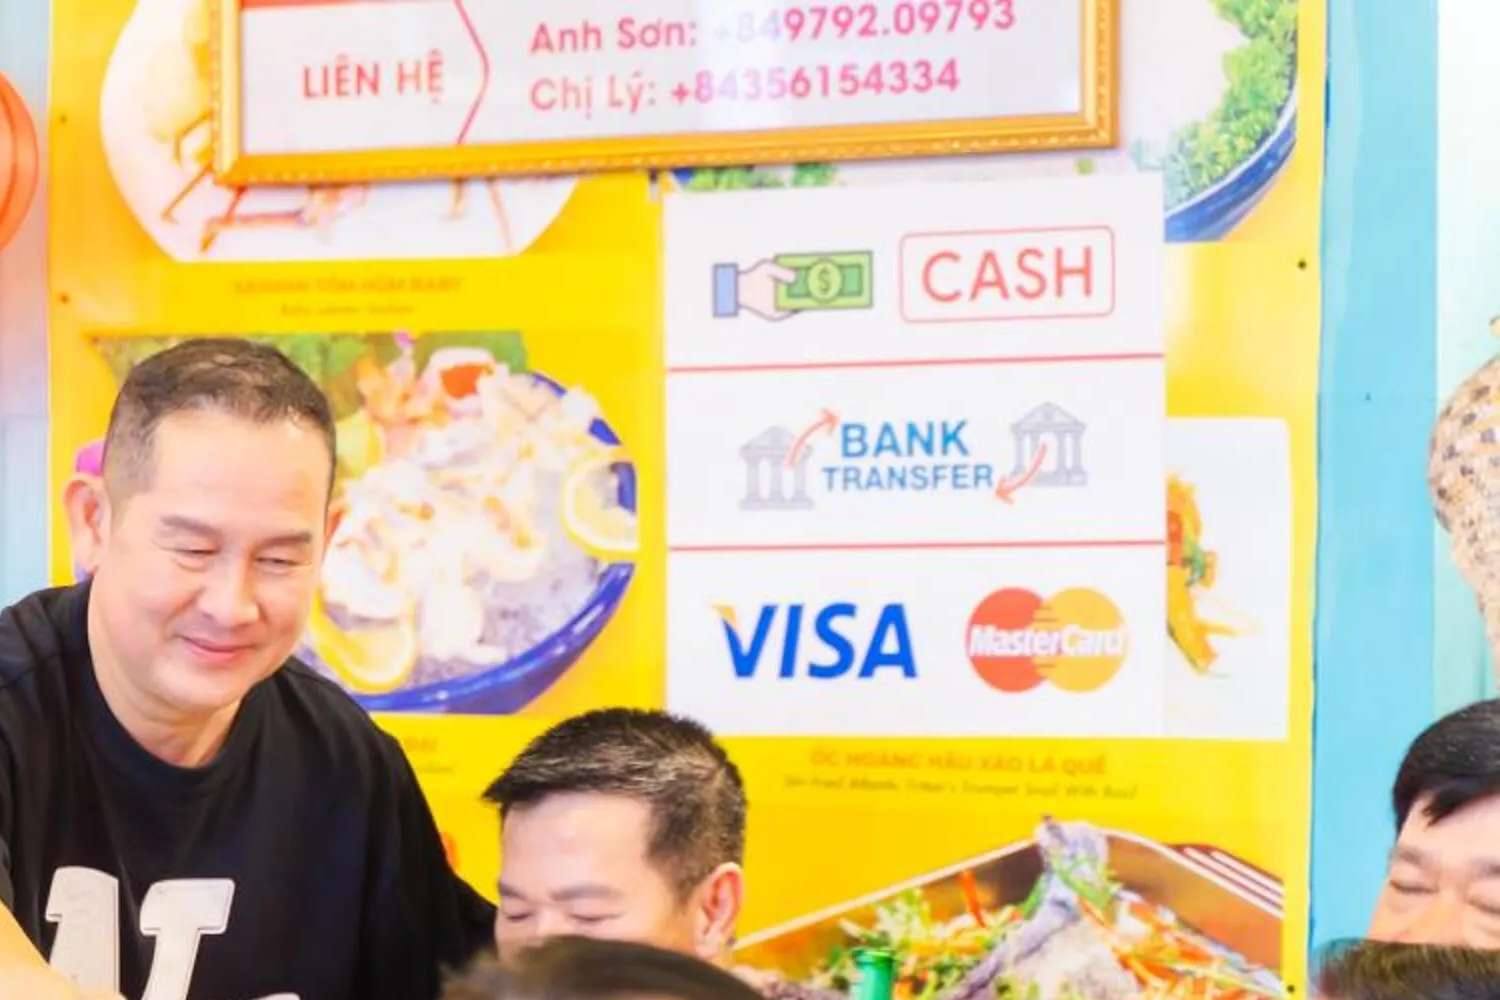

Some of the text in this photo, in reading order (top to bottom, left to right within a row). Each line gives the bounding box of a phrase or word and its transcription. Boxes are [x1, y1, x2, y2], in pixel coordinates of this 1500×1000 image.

[530, 23, 602, 55] Anh
[616, 15, 698, 51] Sơn:
[303, 48, 443, 104] LIÊN HỆ
[529, 58, 960, 119] Chị Lý: +84356154334
[921, 245, 1093, 303] CASH
[840, 419, 970, 458] BANK
[821, 463, 994, 492] TRANSFER
[711, 602, 918, 680] VISA
[969, 623, 1125, 658] MasterCard
